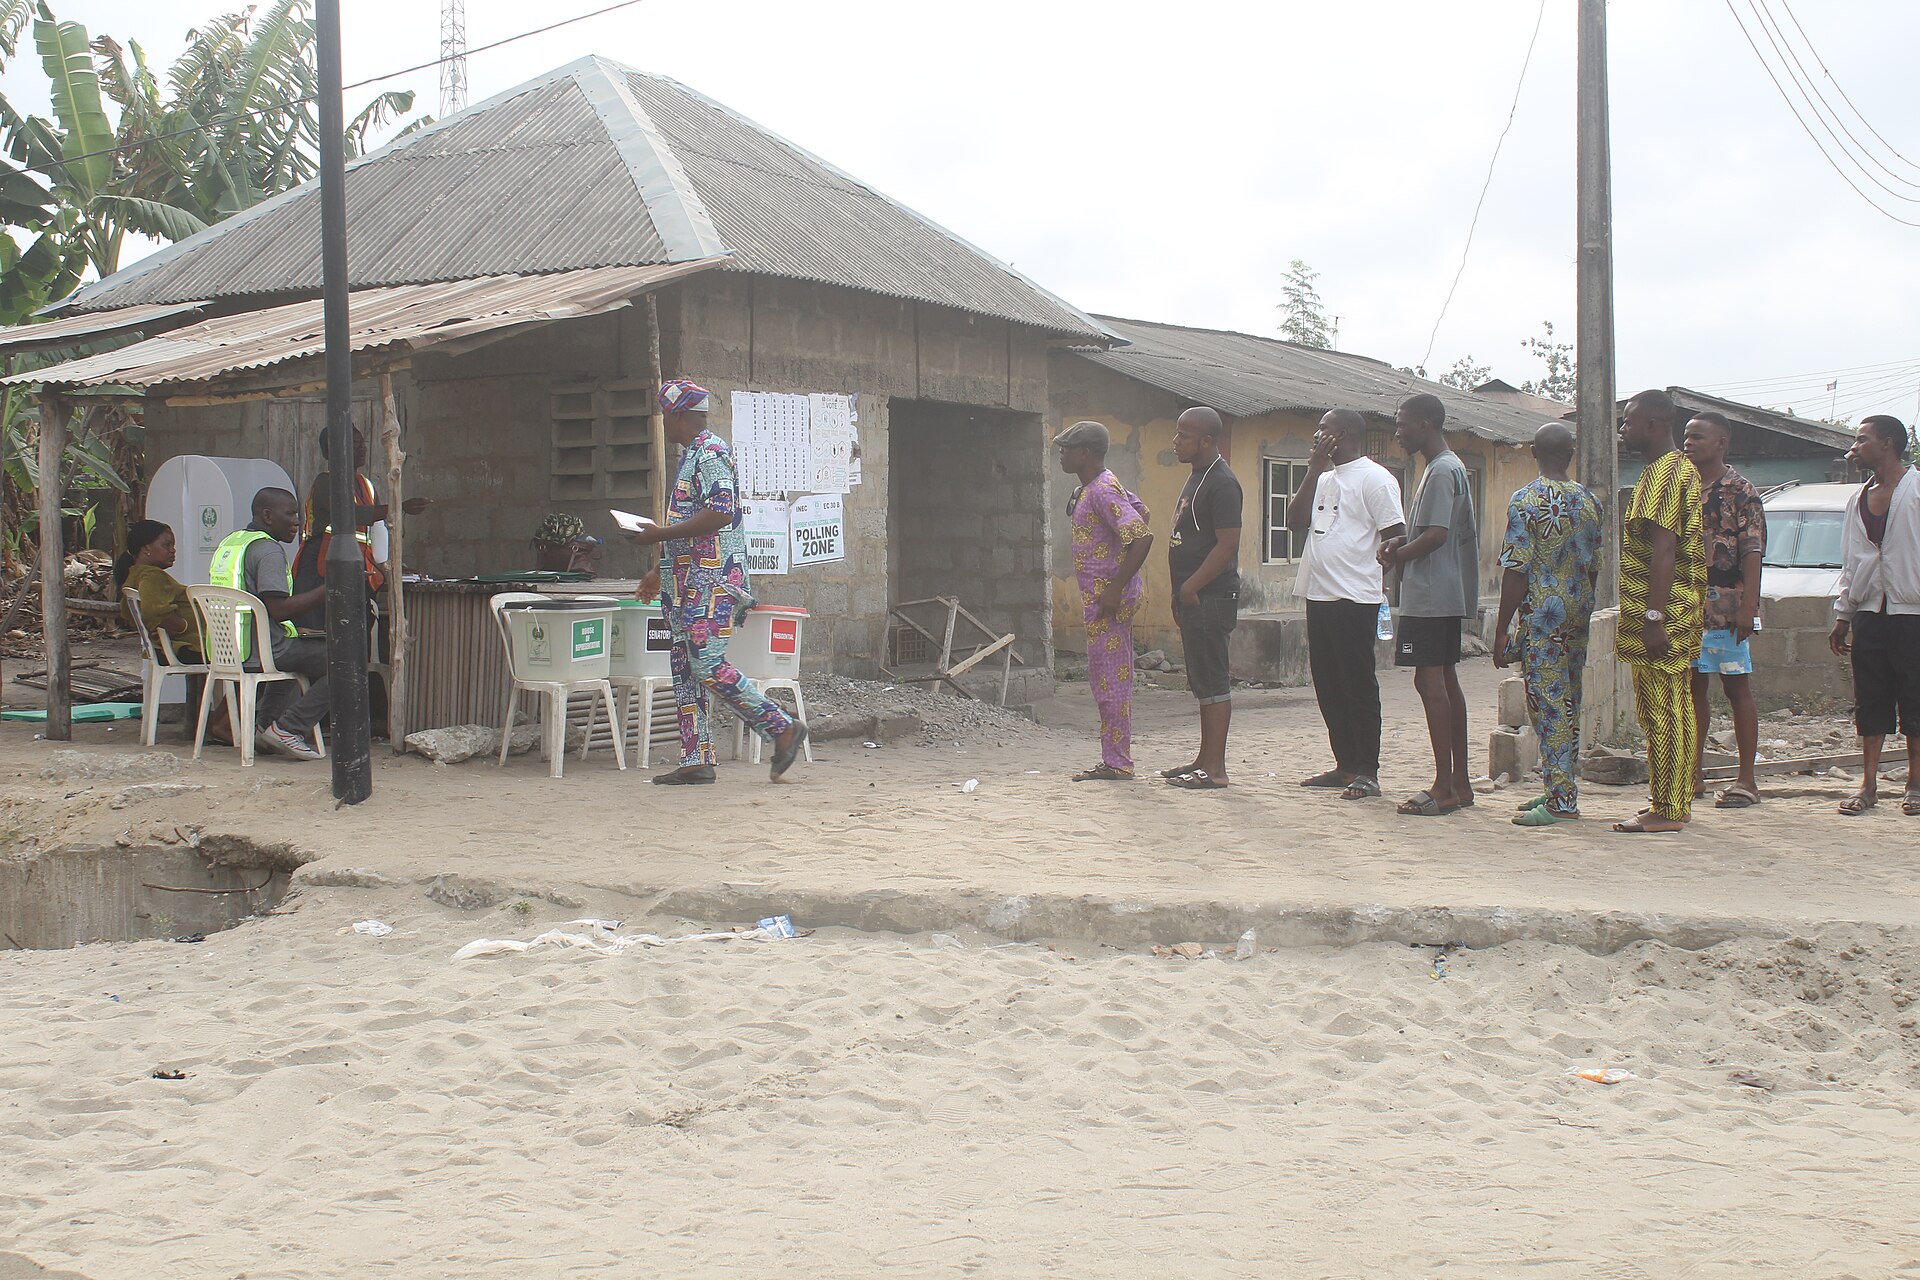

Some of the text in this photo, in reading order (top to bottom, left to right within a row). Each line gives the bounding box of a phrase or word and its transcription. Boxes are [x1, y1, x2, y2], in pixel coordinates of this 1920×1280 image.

[742, 505, 752, 515] EC
[795, 505, 808, 513] INEC
[823, 502, 830, 510] EC
[795, 525, 839, 542] POLLING
[750, 538, 775, 549] VOTING
[802, 539, 835, 557] ZONE
[748, 555, 779, 570] ROGRESS
[648, 629, 671, 640] SENATORI
